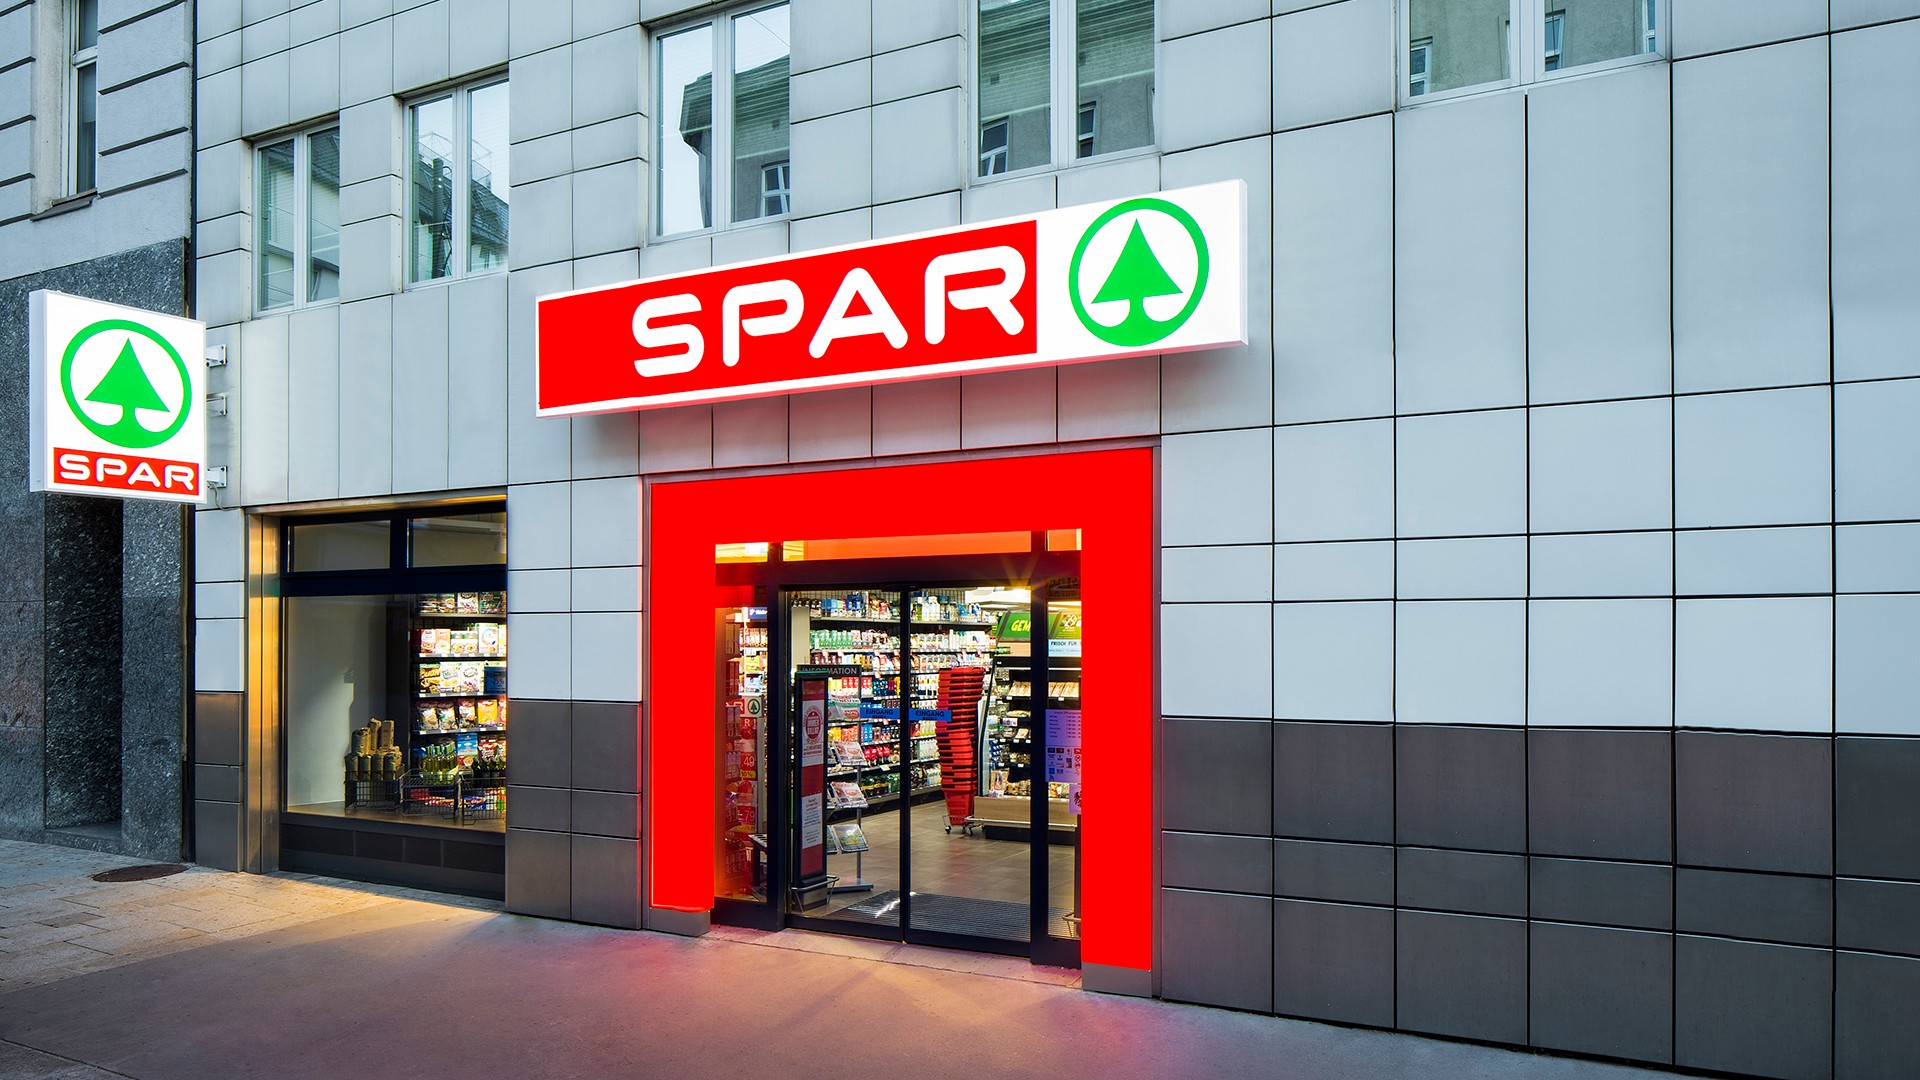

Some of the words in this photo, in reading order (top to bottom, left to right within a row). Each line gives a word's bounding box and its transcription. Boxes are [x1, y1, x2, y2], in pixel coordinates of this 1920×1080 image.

[632, 245, 1026, 378] SPAR
[59, 453, 195, 491] SPAR
[865, 708, 894, 716] EINGANG
